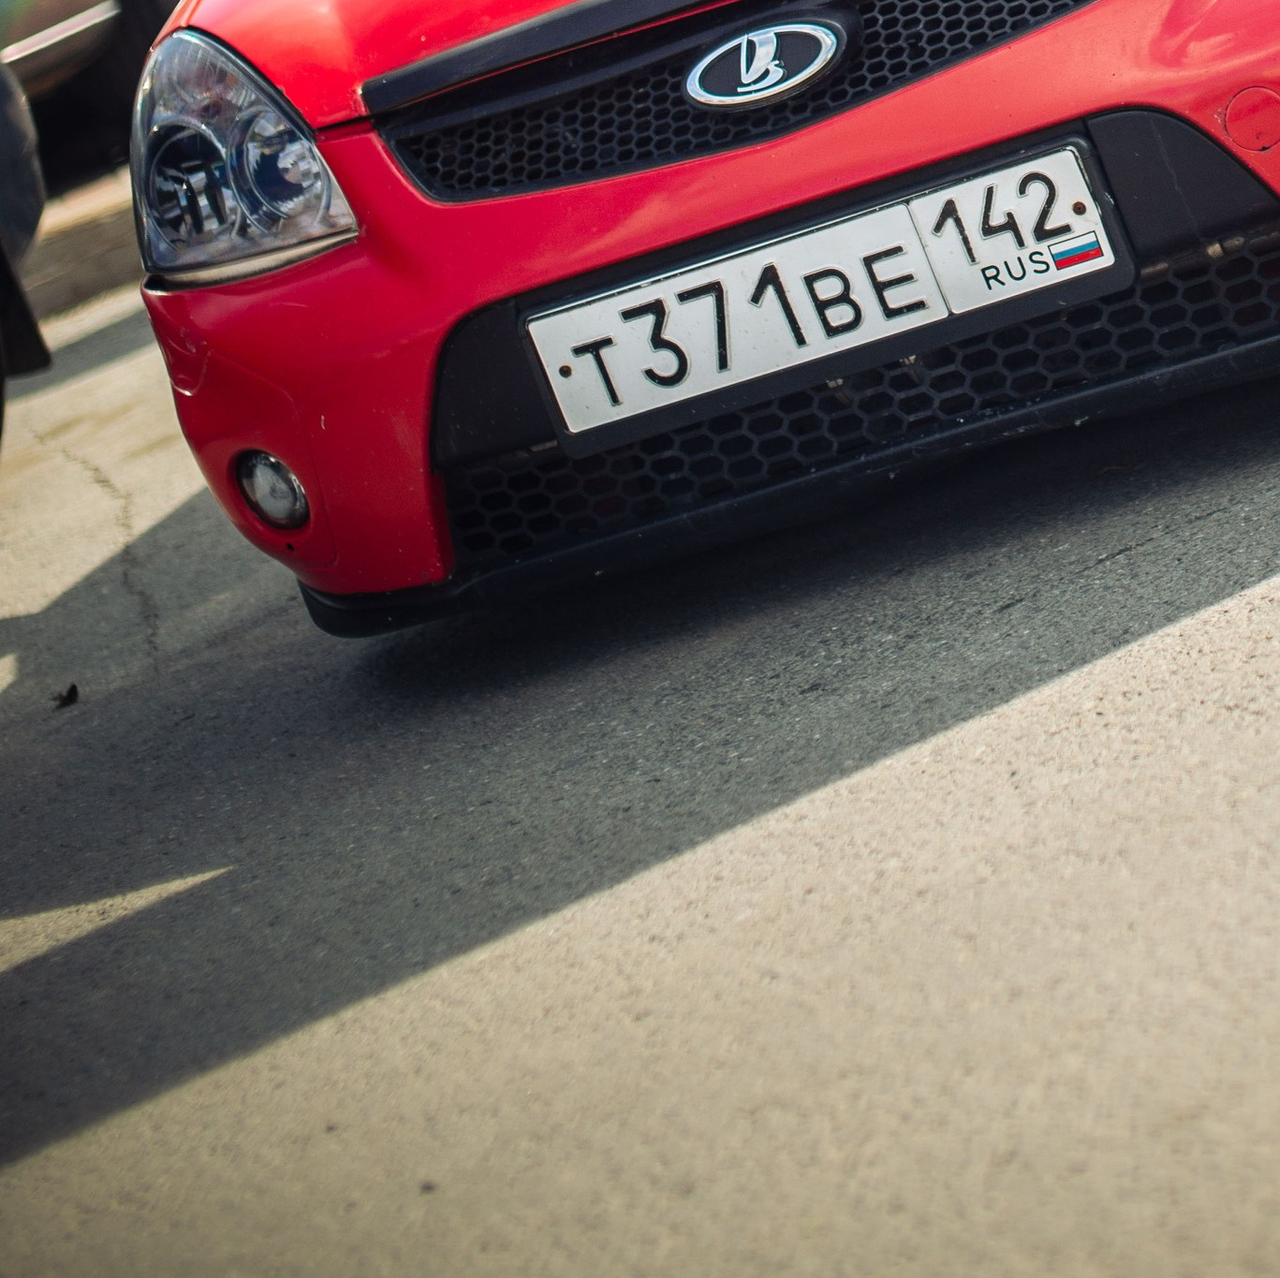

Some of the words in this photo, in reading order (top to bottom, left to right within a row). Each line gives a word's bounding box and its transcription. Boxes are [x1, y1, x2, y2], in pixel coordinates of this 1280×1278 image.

[571, 244, 928, 408] Т371ВЕ
[932, 170, 1074, 265] 142
[980, 250, 1051, 291] RUS
